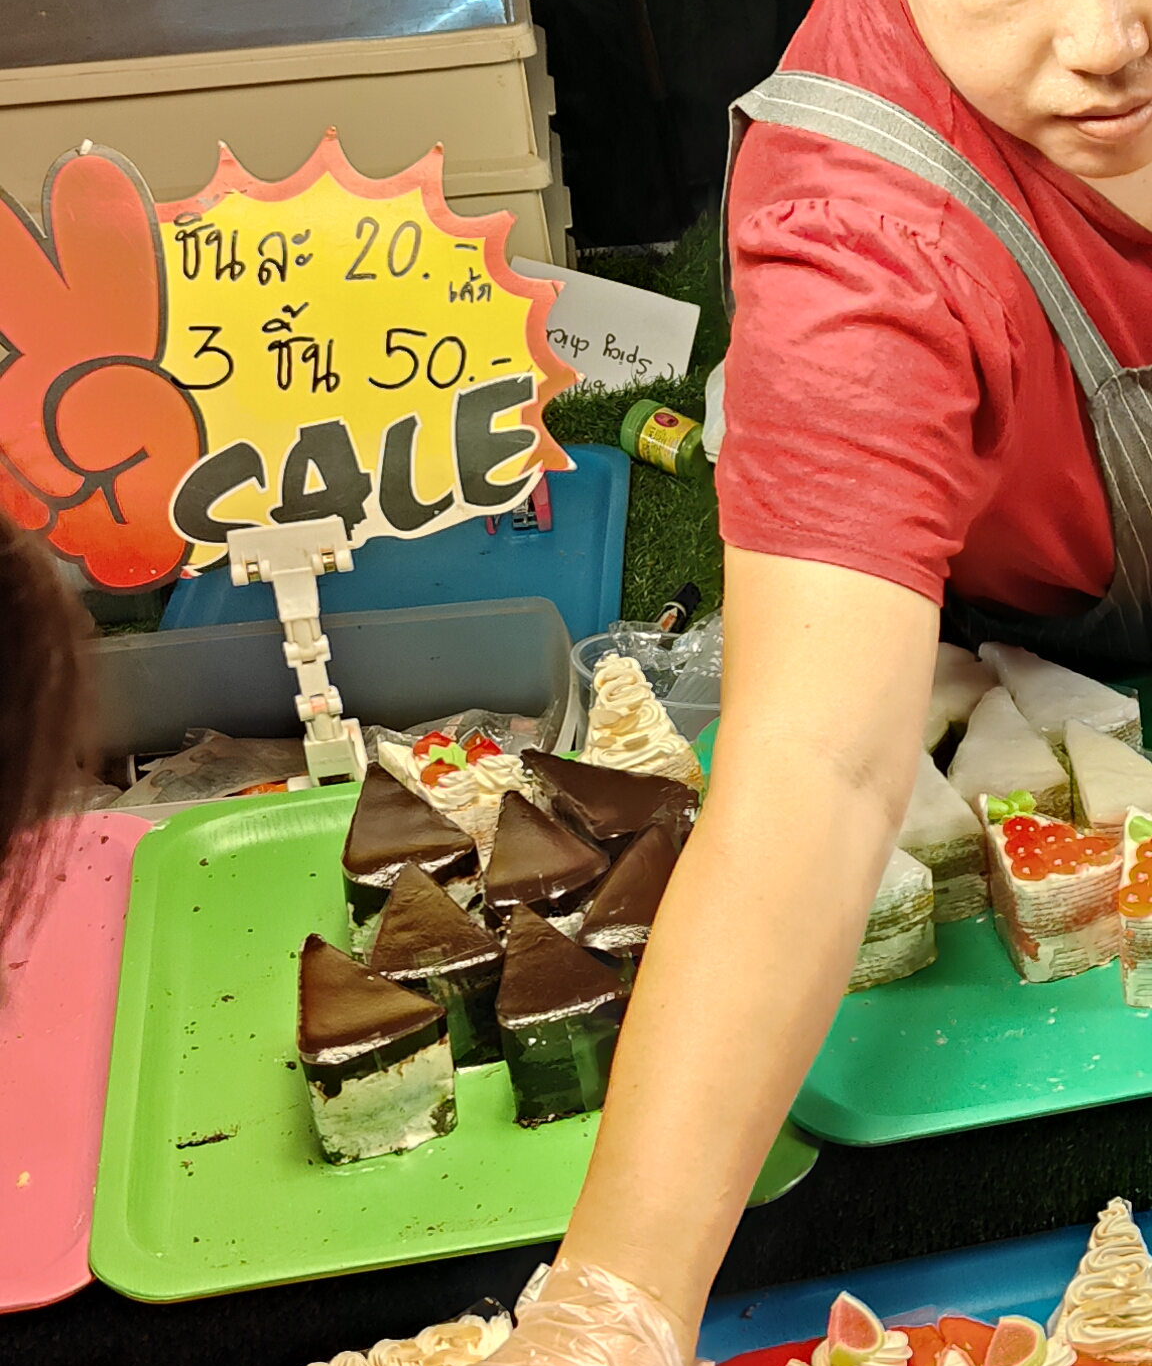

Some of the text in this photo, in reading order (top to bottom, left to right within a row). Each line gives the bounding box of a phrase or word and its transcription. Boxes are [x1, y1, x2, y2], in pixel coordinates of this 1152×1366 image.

[171, 325, 234, 391] 3
[261, 302, 341, 393] ชิ้น
[172, 374, 542, 573] SALE
